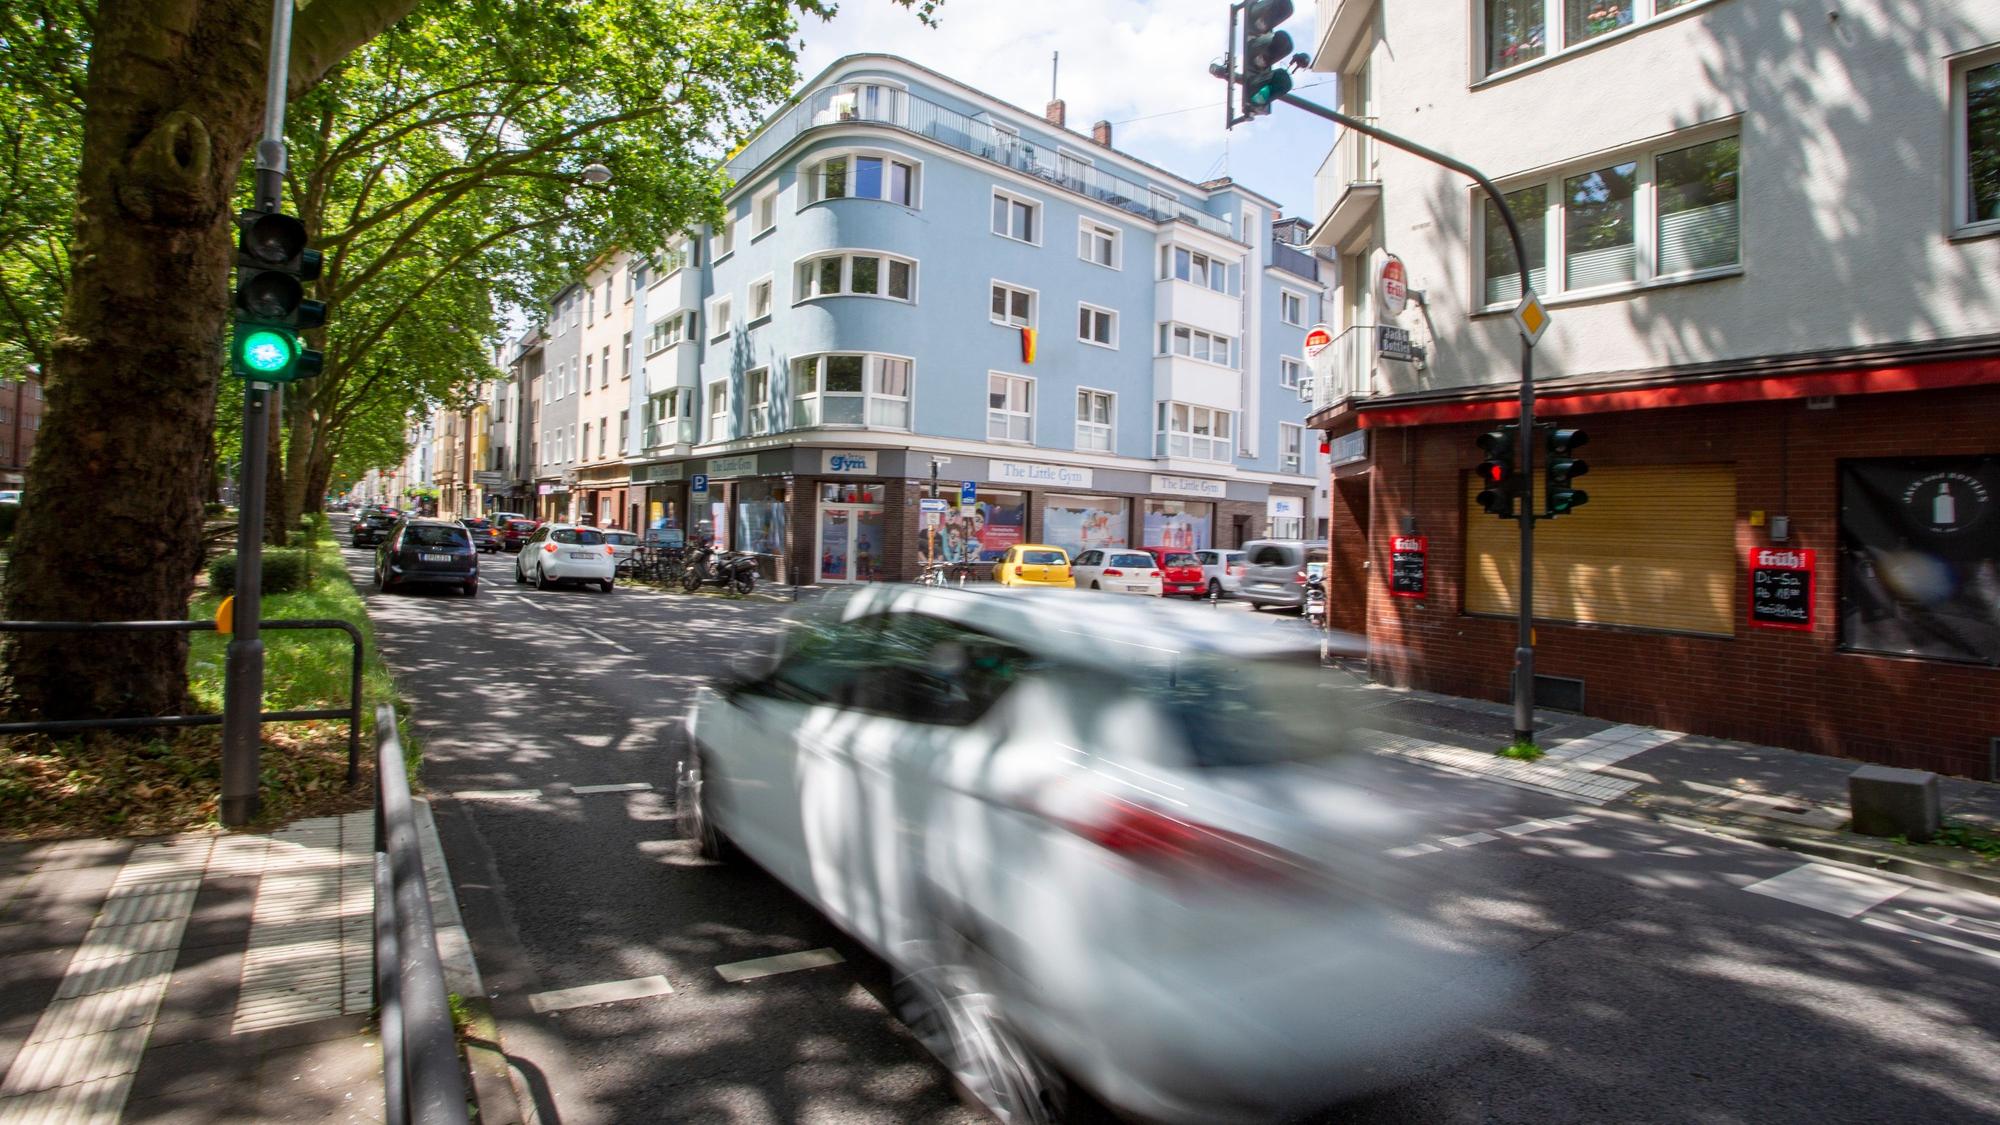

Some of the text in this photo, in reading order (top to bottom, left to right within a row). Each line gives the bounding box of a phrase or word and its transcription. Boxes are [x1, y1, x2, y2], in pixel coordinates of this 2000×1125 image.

[830, 455, 868, 471] gym
[1003, 463, 1083, 485] The Little Gym
[1161, 477, 1220, 496] The Little Gym
